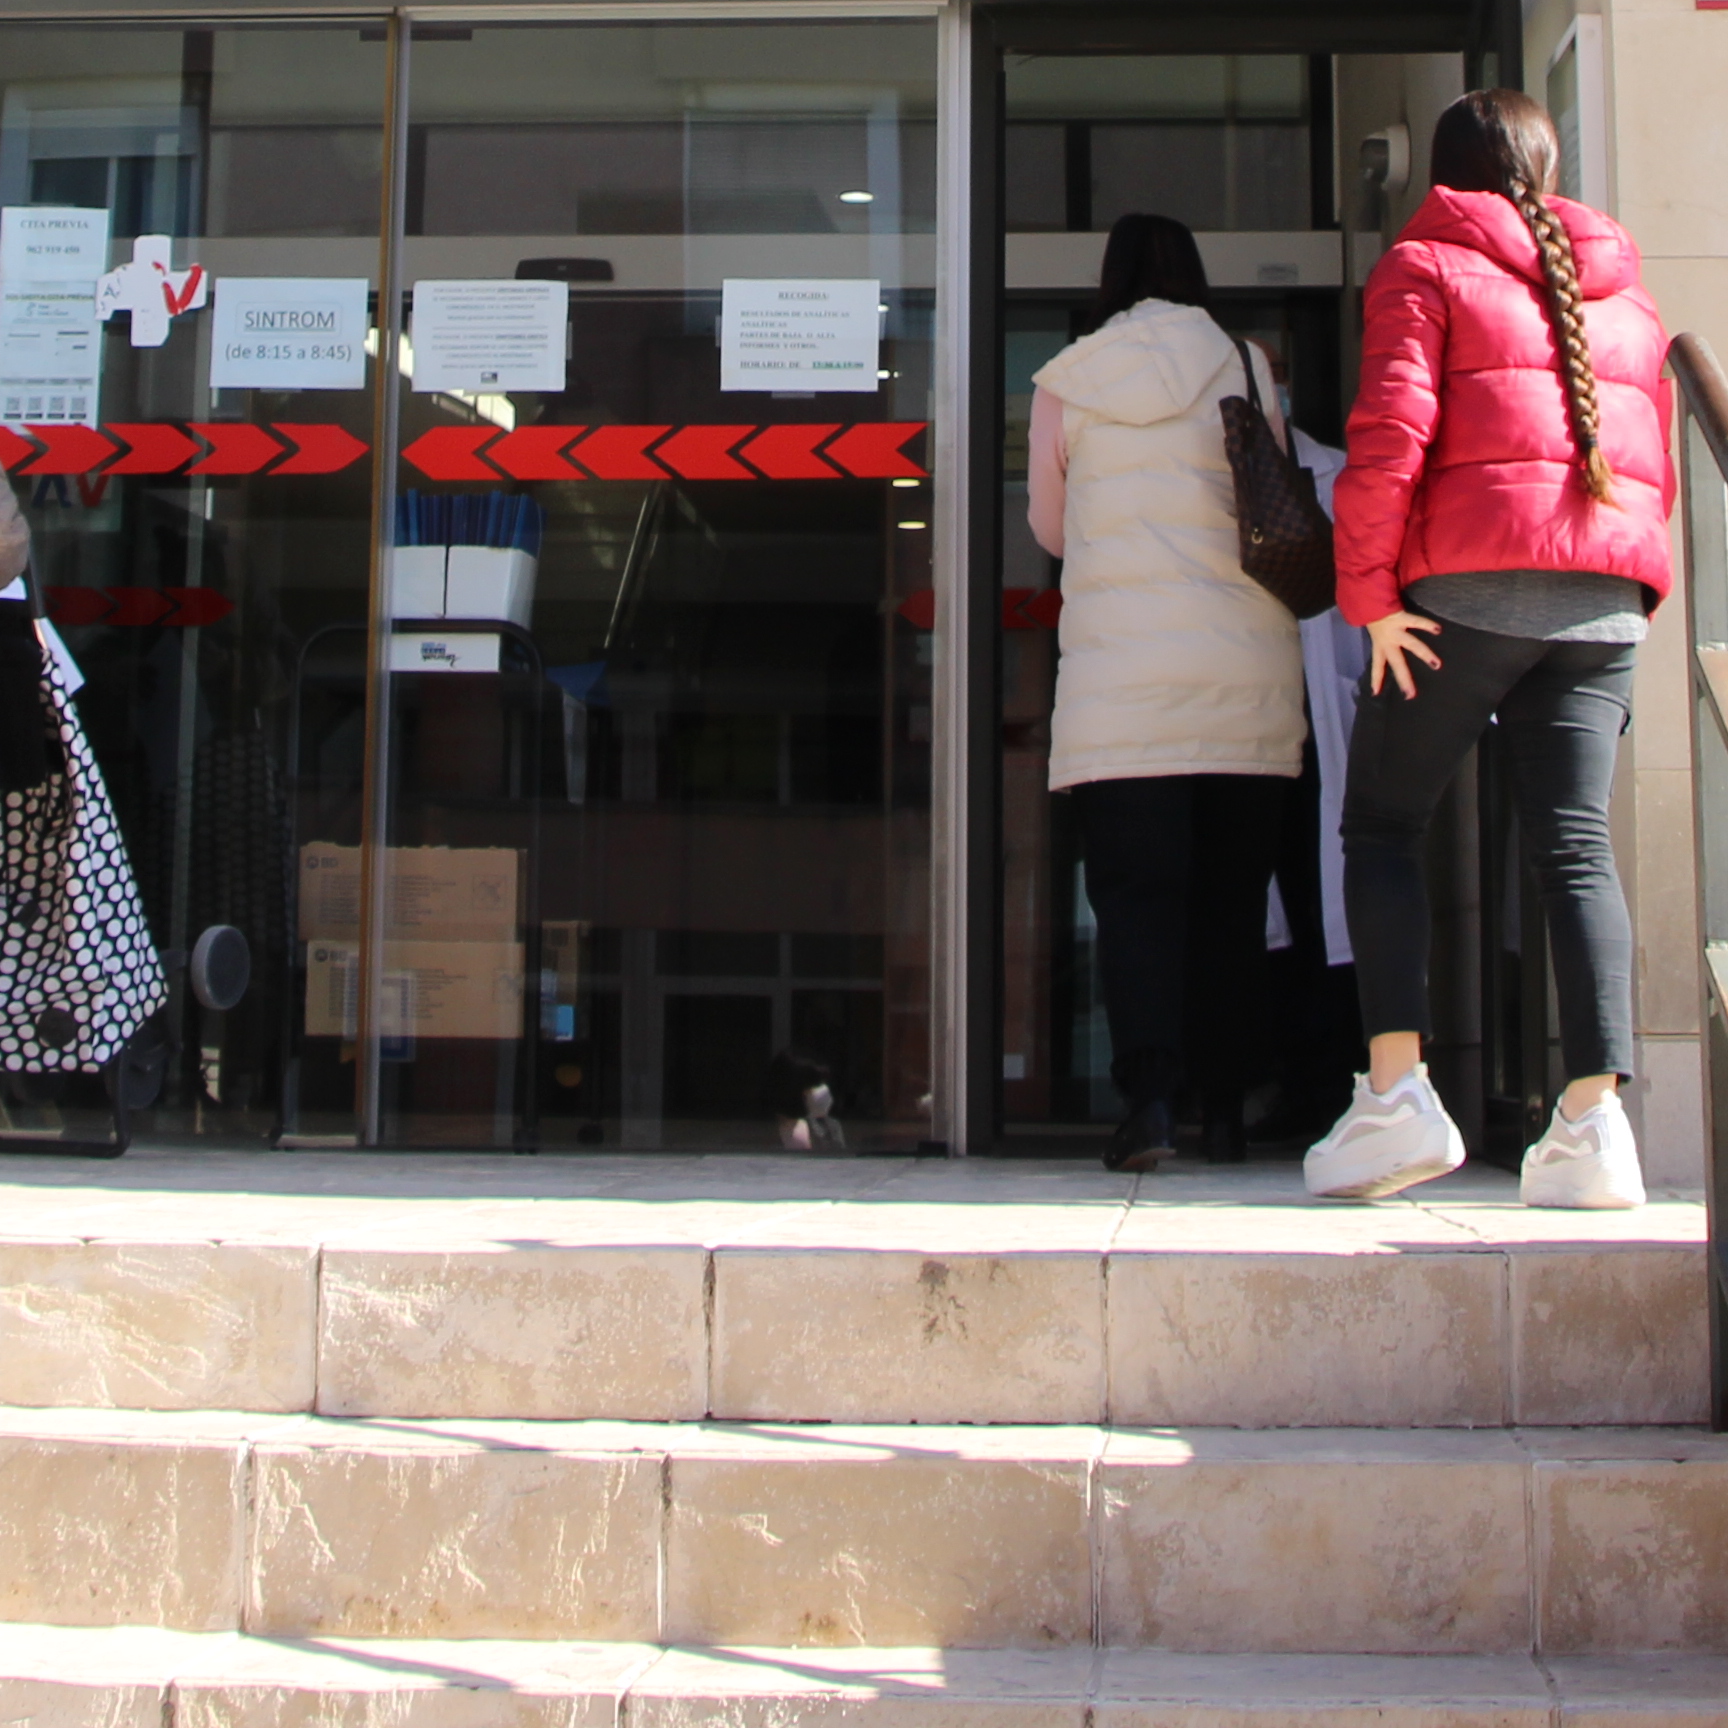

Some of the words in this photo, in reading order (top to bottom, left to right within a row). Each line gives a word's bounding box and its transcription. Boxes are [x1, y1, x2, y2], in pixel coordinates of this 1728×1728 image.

[20, 219, 46, 229] CITA
[48, 220, 89, 229] PREVIA
[244, 310, 335, 330] SINTROM
[225, 343, 251, 362] (de
[256, 344, 292, 360] 8:15
[297, 348, 306, 360] a
[310, 344, 352, 363] 8:45)
